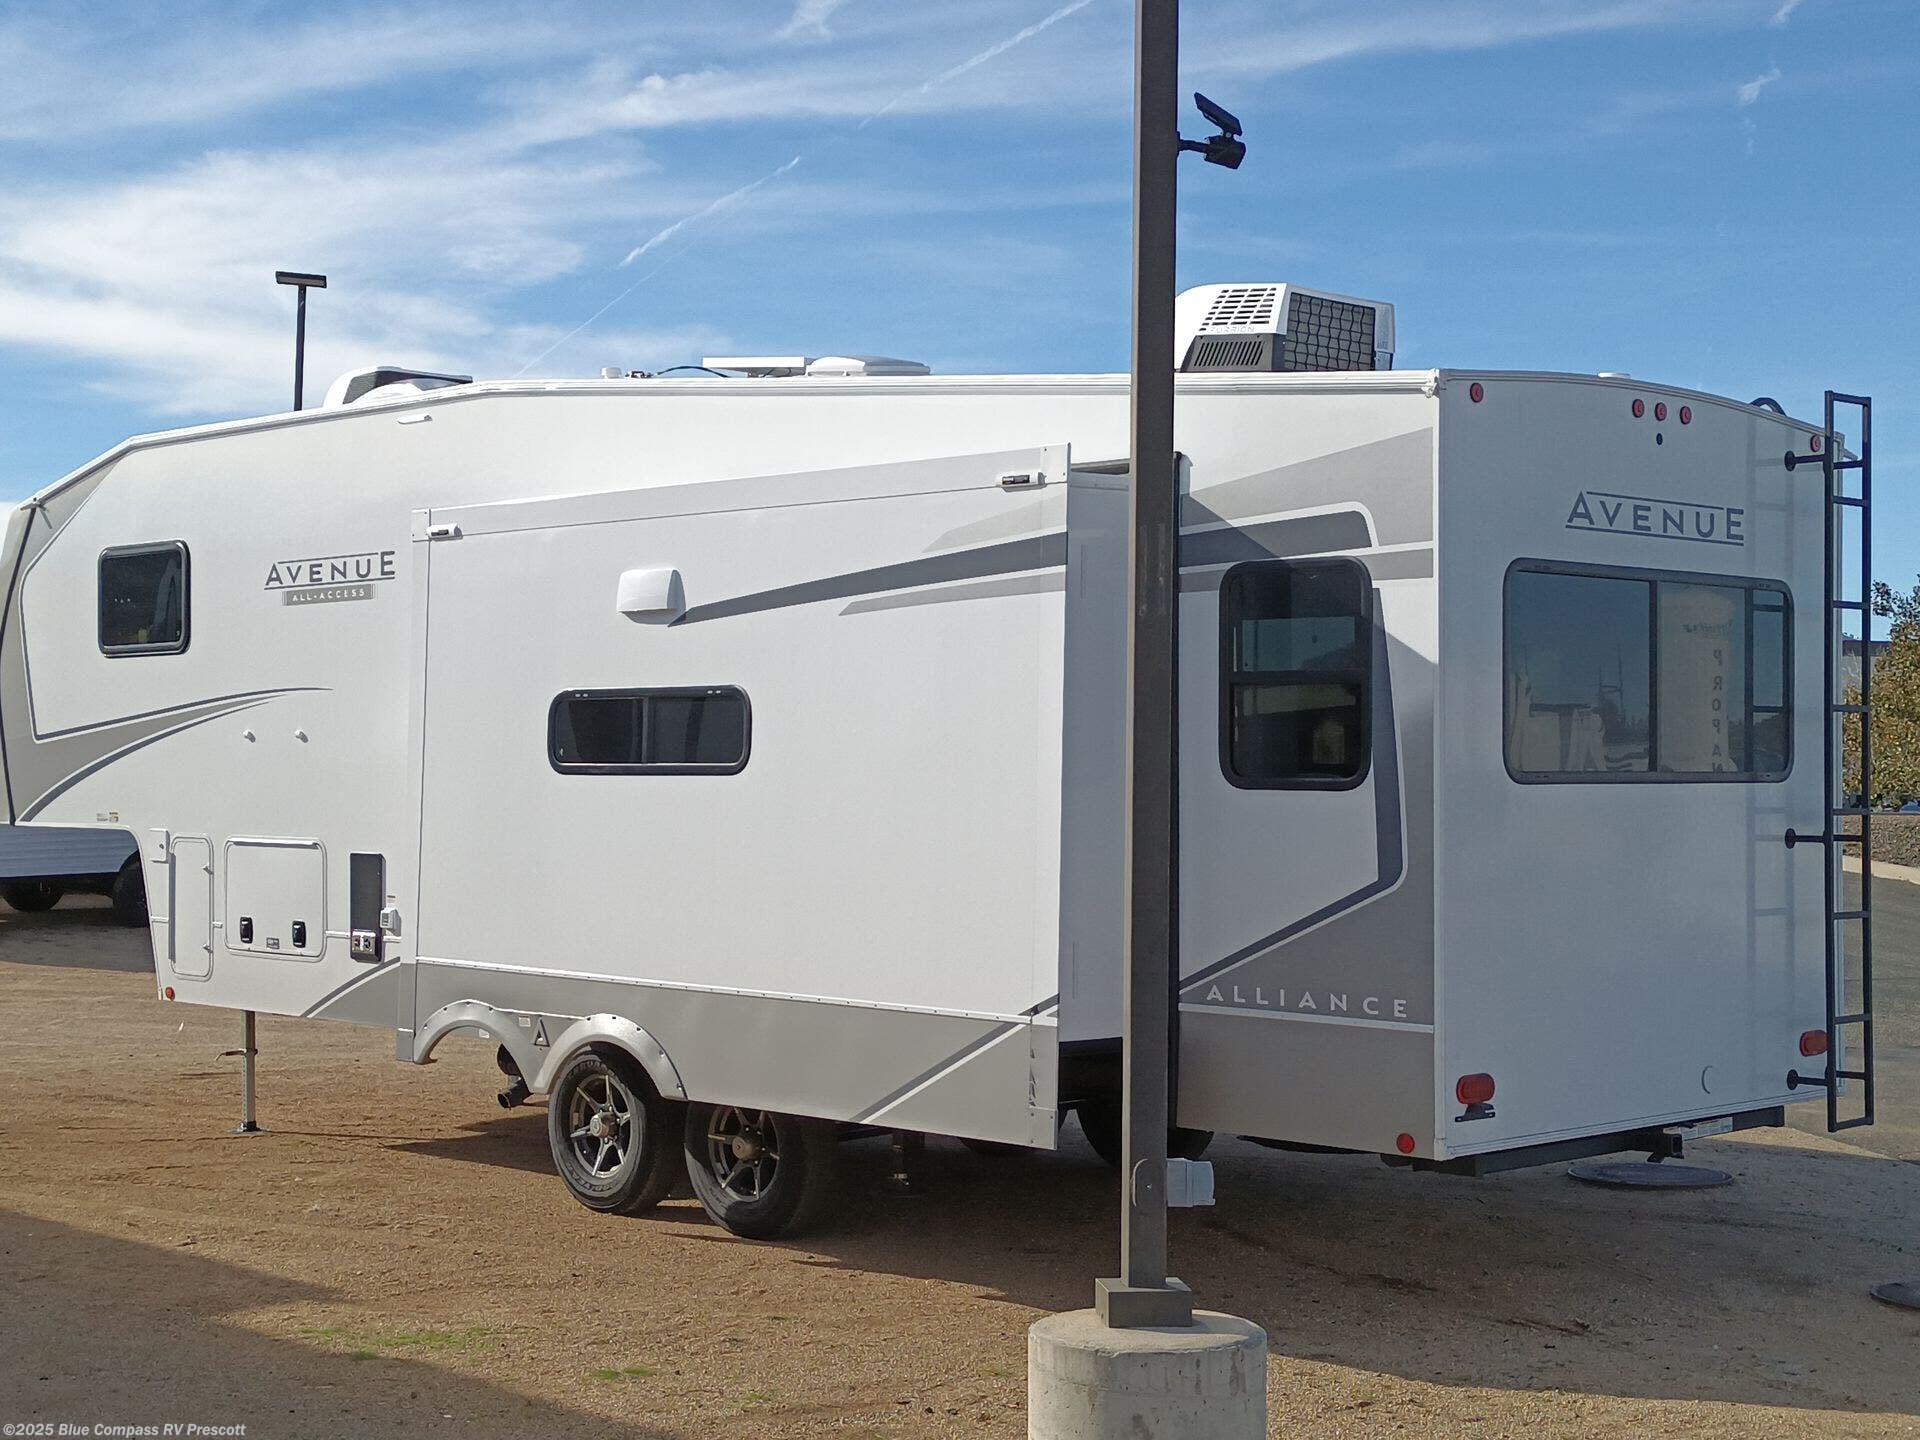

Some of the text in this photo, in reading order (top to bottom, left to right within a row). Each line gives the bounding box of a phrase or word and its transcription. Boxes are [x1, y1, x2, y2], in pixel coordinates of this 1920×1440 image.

[1567, 491, 1744, 541] AVENUE
[265, 551, 395, 586] AVENUE
[292, 588, 366, 602] ALL-ACCESS
[1206, 984, 1408, 1018] ALLIANCE
